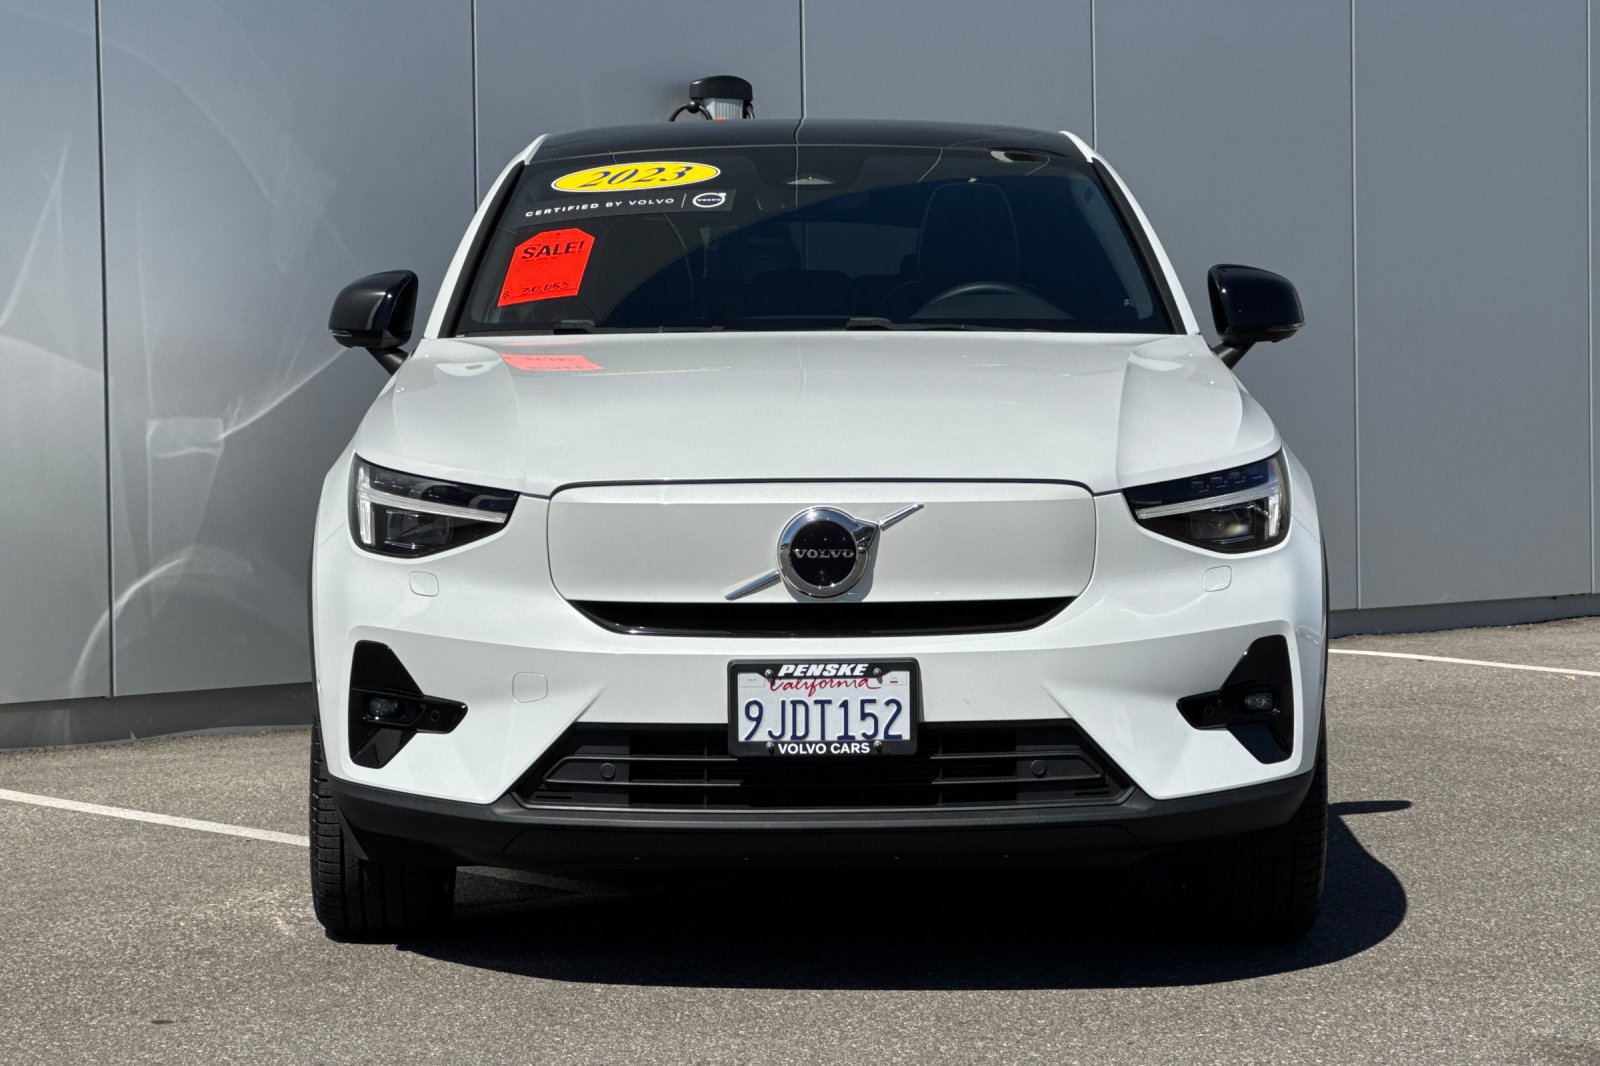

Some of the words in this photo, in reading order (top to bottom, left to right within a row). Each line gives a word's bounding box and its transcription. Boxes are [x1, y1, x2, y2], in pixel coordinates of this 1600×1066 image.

[578, 165, 693, 187] 2023
[525, 203, 599, 218] CERTIFIED
[629, 198, 674, 206] VOLVO
[521, 241, 584, 260] SALE!
[793, 549, 855, 558] VOLVO
[778, 664, 868, 677] PENSKE
[744, 698, 903, 741] 9JDT152
[778, 743, 827, 754] VOLVO
[830, 742, 871, 754] CARS
